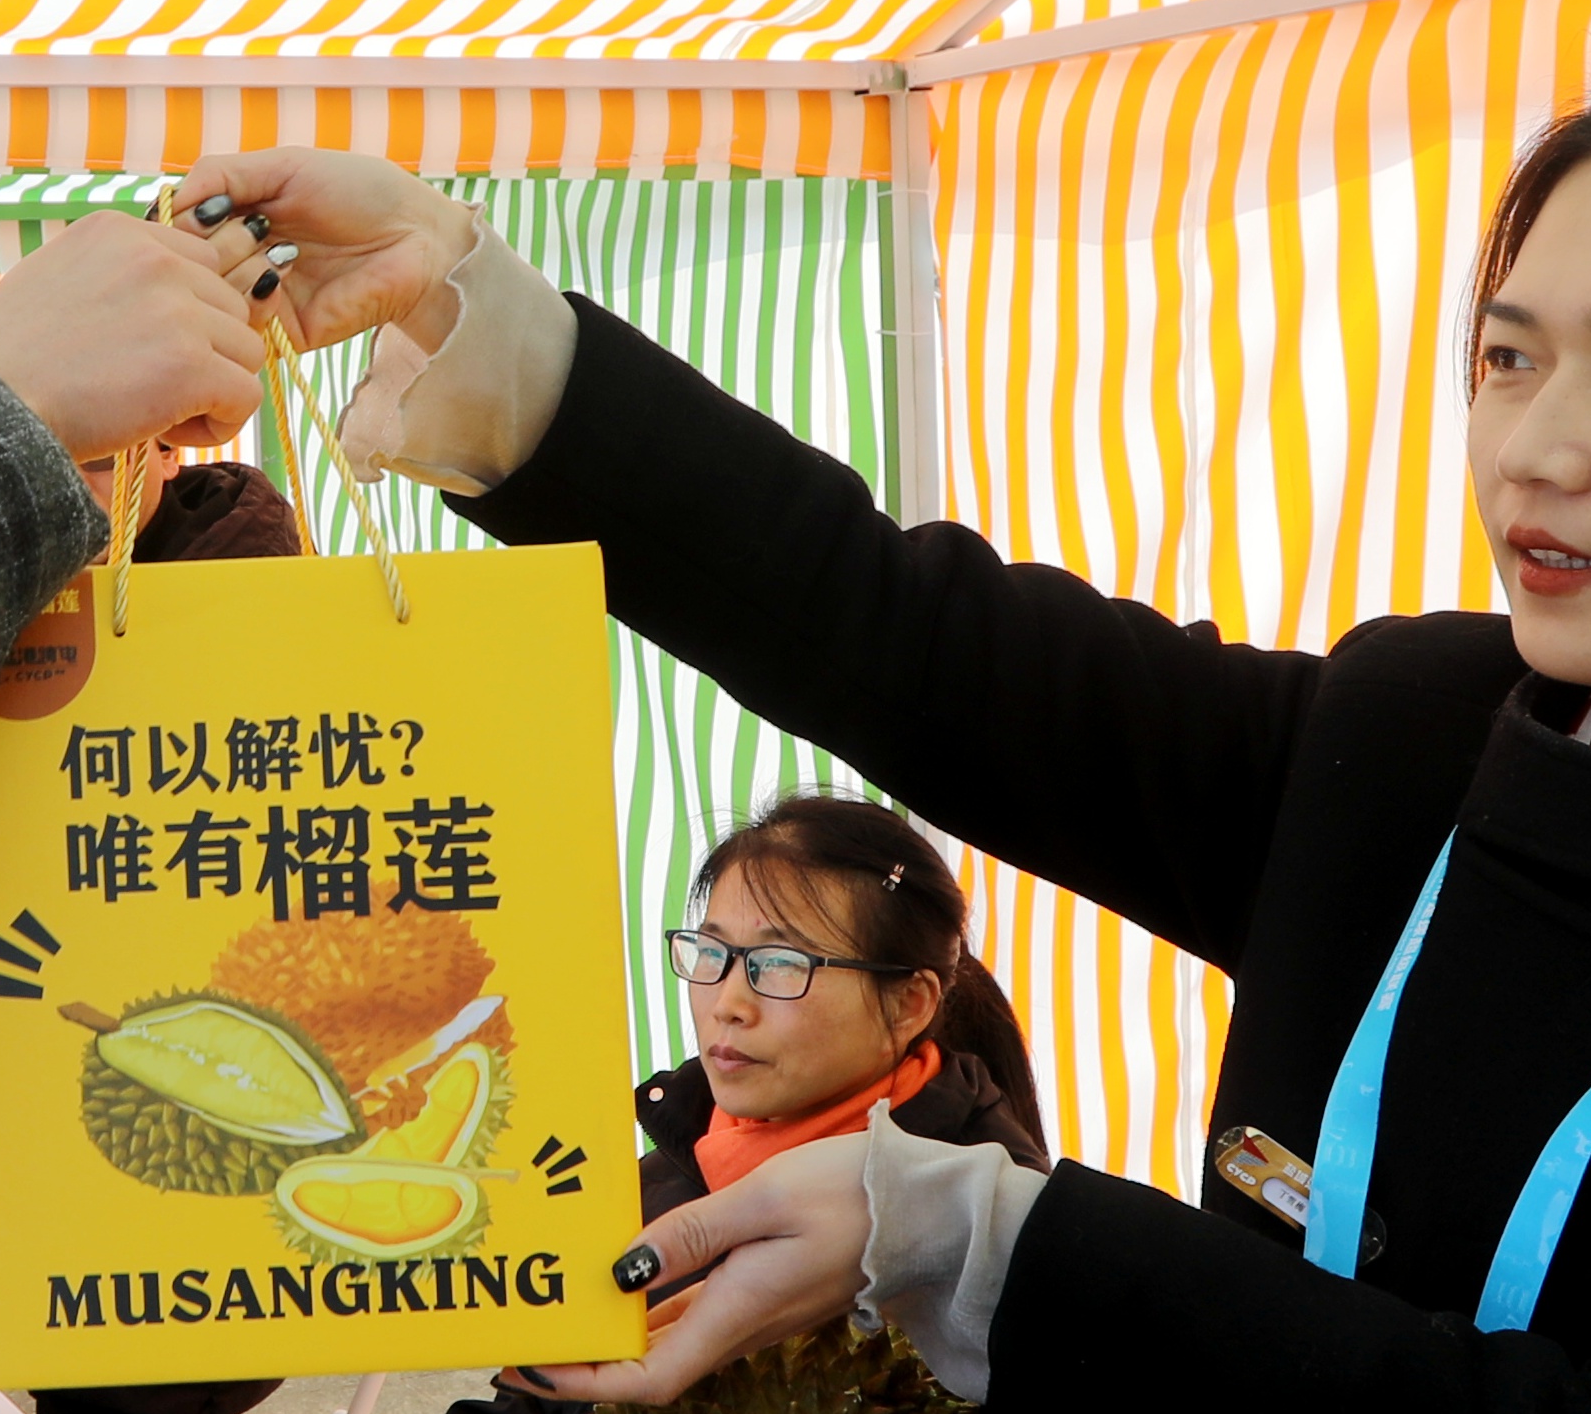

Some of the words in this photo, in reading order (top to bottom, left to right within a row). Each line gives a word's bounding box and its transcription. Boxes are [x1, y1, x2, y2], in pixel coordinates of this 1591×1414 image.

[59, 711, 425, 800] 何以解忧?
[64, 796, 502, 923] 唯有榴莲
[45, 1251, 565, 1329] MUSANGKING
